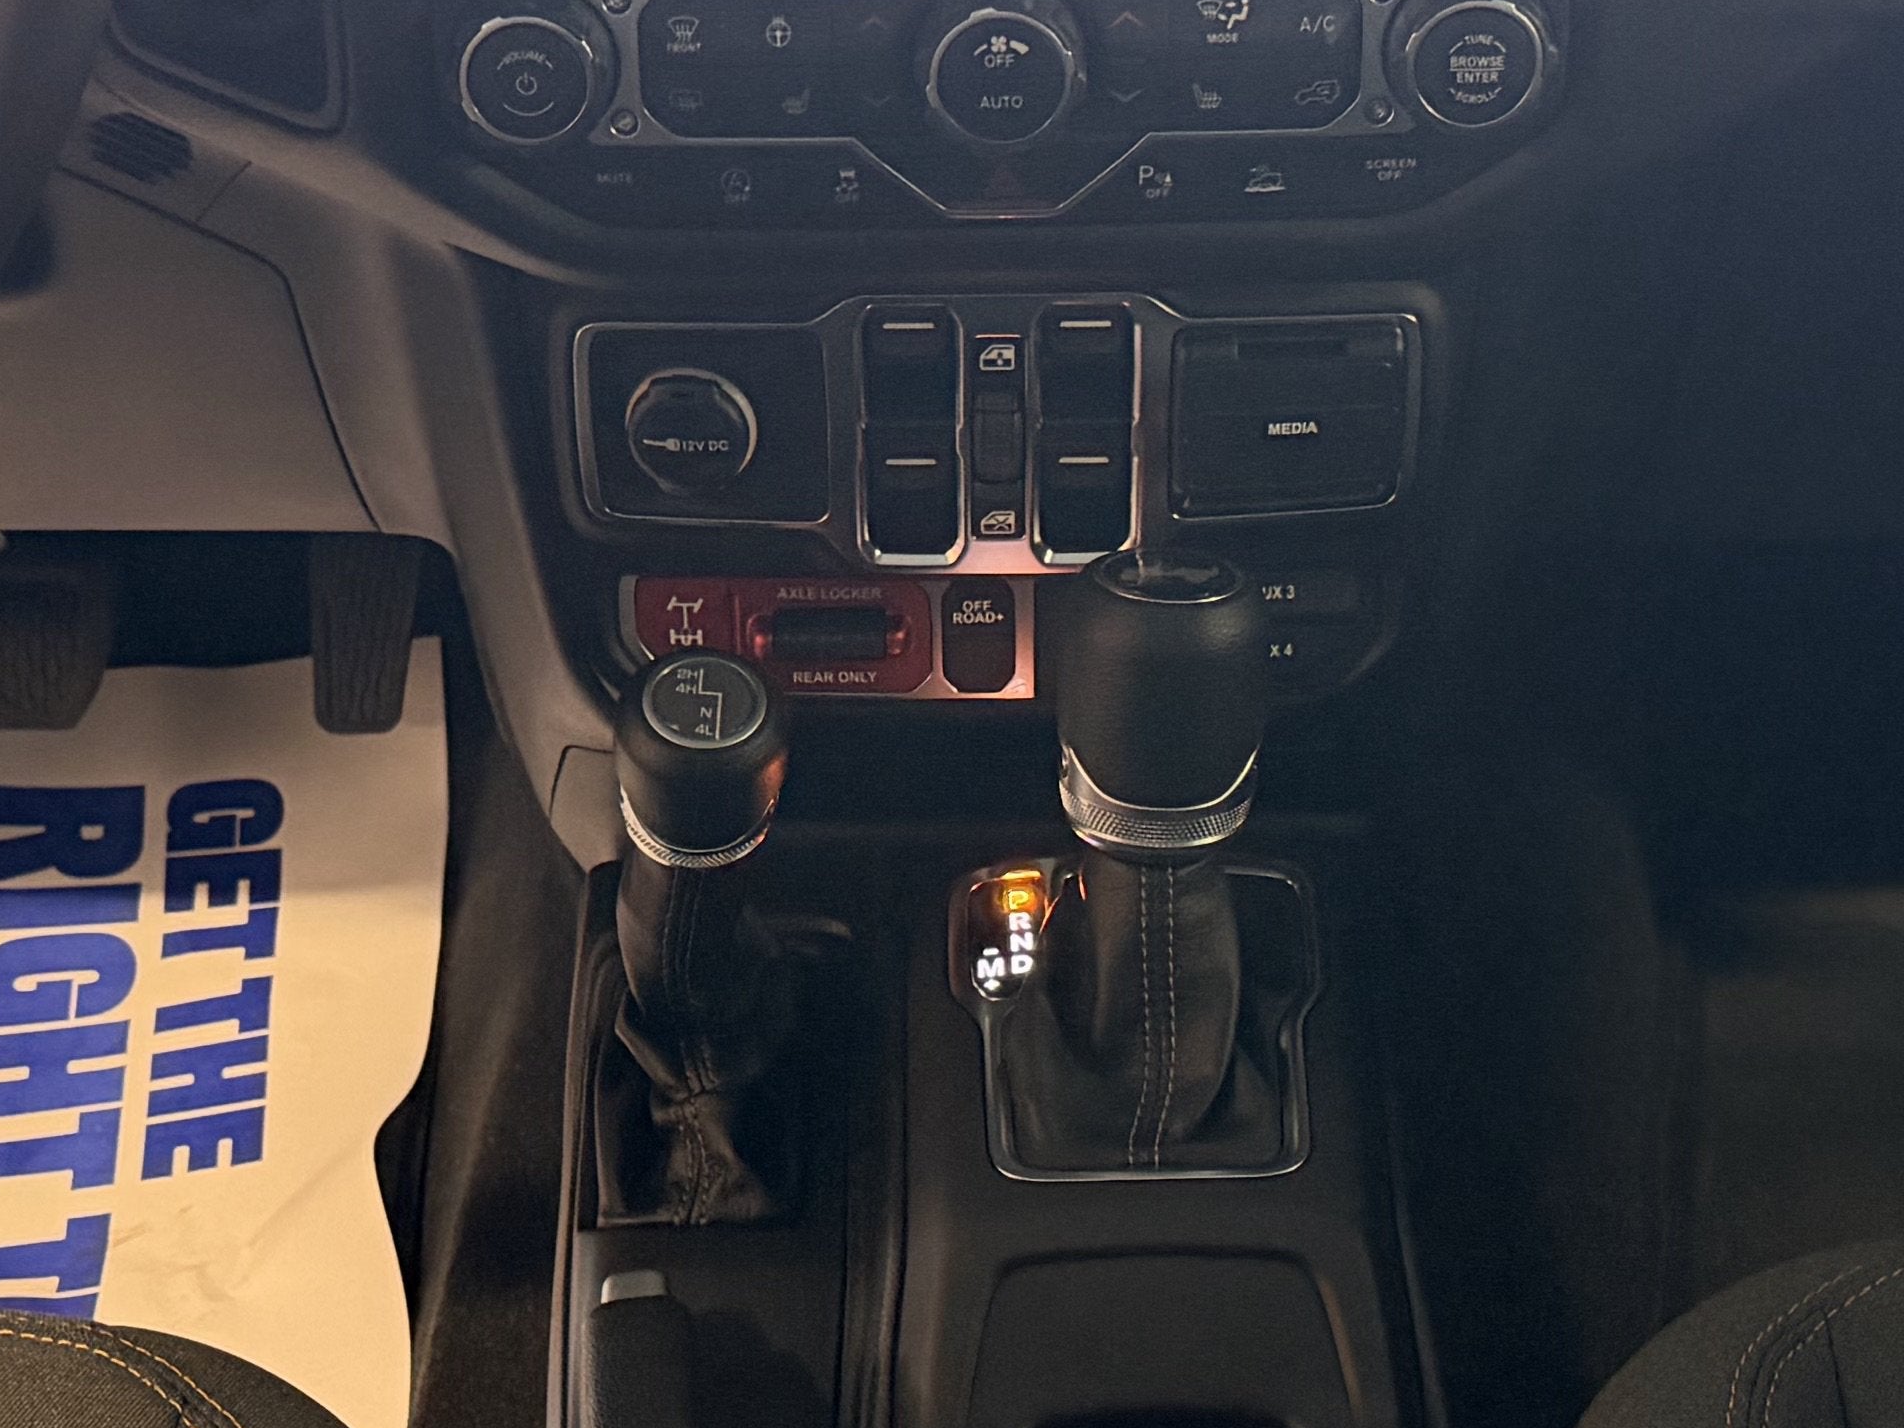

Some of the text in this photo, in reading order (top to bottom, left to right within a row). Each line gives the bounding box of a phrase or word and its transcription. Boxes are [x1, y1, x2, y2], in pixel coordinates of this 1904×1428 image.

[1299, 13, 1338, 36] A/C
[1206, 32, 1239, 45] MODE
[983, 53, 1016, 69] OFF
[1449, 56, 1506, 68] BROWSE
[1456, 71, 1499, 84] ENTER
[980, 95, 1024, 110] AUTO
[1267, 420, 1319, 436] MEDIA
[776, 585, 883, 600] AXLE LOCKER
[1286, 583, 1296, 600] 3
[962, 600, 993, 613] OFF
[793, 670, 879, 684] REAR ONLY
[675, 682, 697, 695] 4H
[700, 706, 713, 719] N
[694, 723, 714, 736] 4L
[1007, 890, 1030, 910] P
[1008, 911, 1033, 932] R
[1009, 931, 1035, 953] N
[976, 956, 1006, 980] M
[1010, 953, 1035, 976] D
[141, 778, 285, 1183] GET THE
